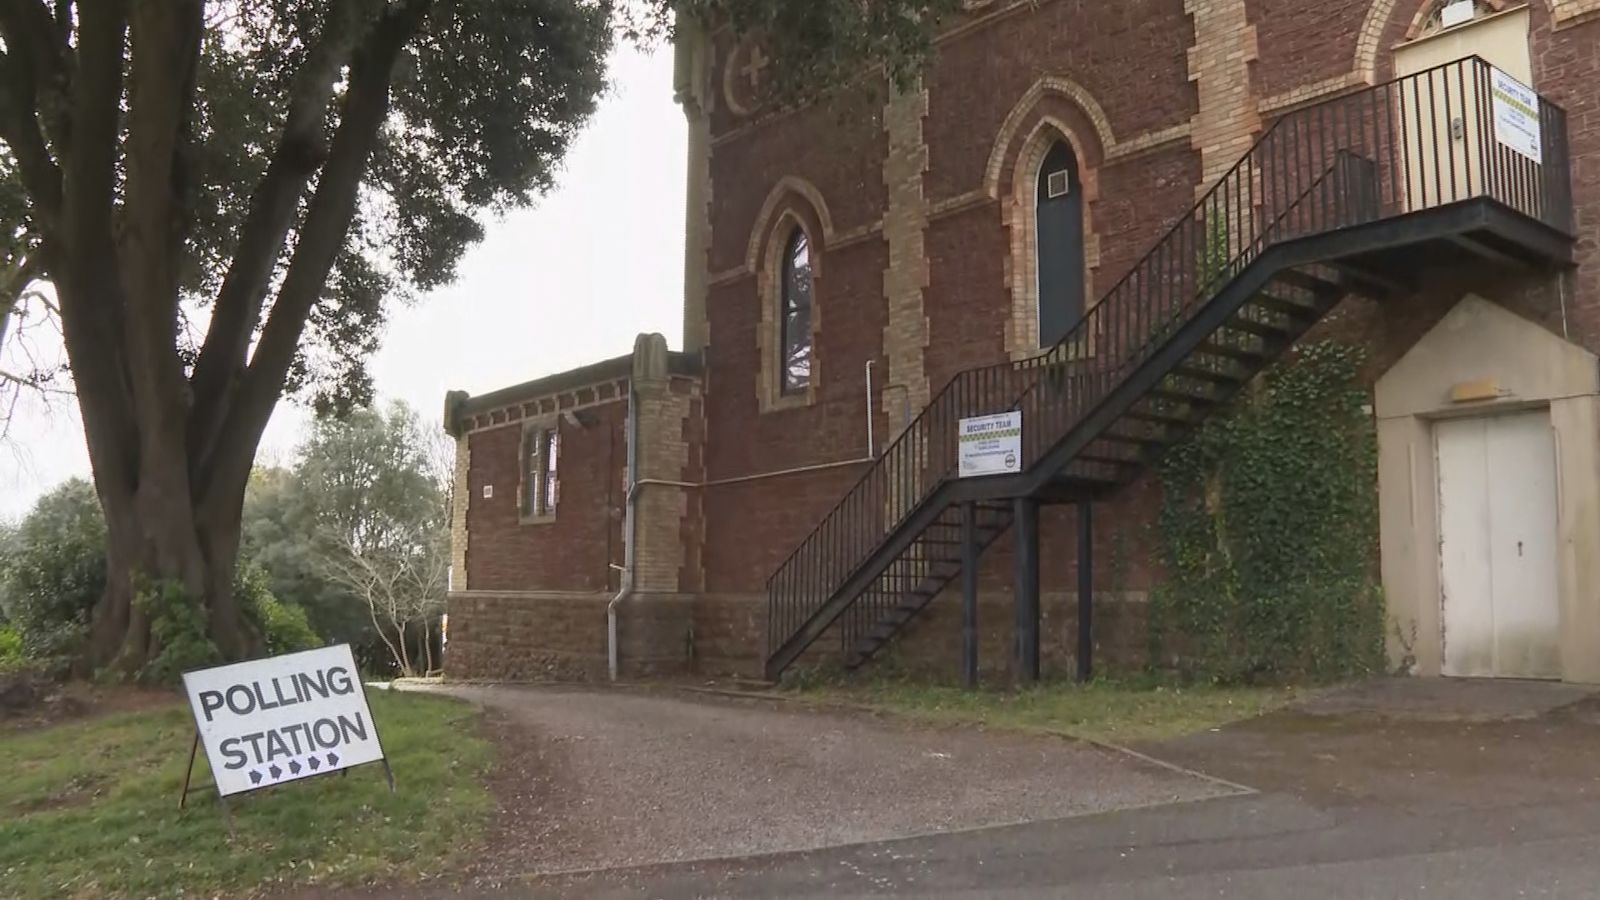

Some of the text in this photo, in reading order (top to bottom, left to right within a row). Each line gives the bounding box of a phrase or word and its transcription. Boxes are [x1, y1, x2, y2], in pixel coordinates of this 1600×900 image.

[966, 420, 1012, 433] SECURITY TEAM
[198, 666, 355, 722] POLLING
[219, 711, 368, 770] STATION
